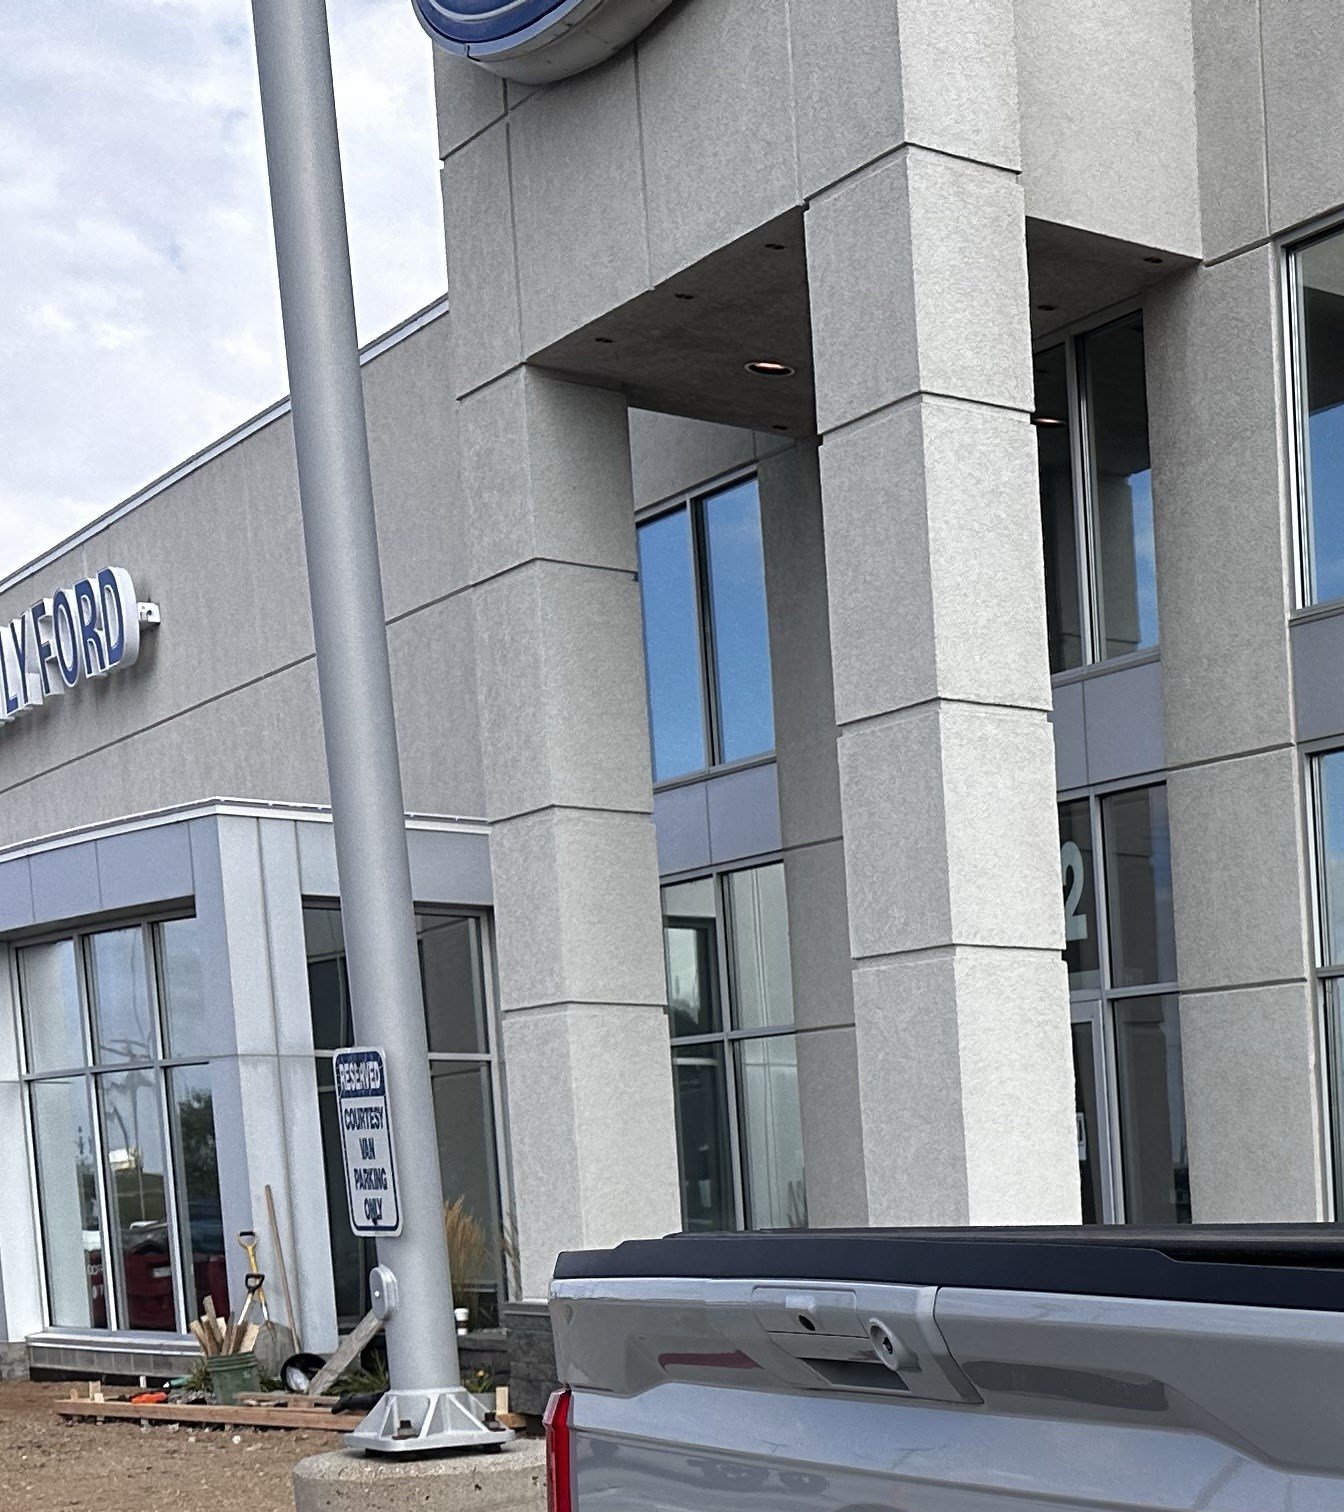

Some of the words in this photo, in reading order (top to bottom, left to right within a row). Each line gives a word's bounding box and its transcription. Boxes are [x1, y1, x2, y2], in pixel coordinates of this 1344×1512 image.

[31, 566, 131, 697] FORD
[338, 1060, 381, 1091] RESERVED
[344, 1106, 385, 1131] COURTESY
[359, 1137, 377, 1160] VAN
[353, 1167, 388, 1191] PARKING
[364, 1197, 383, 1222] ONLY
